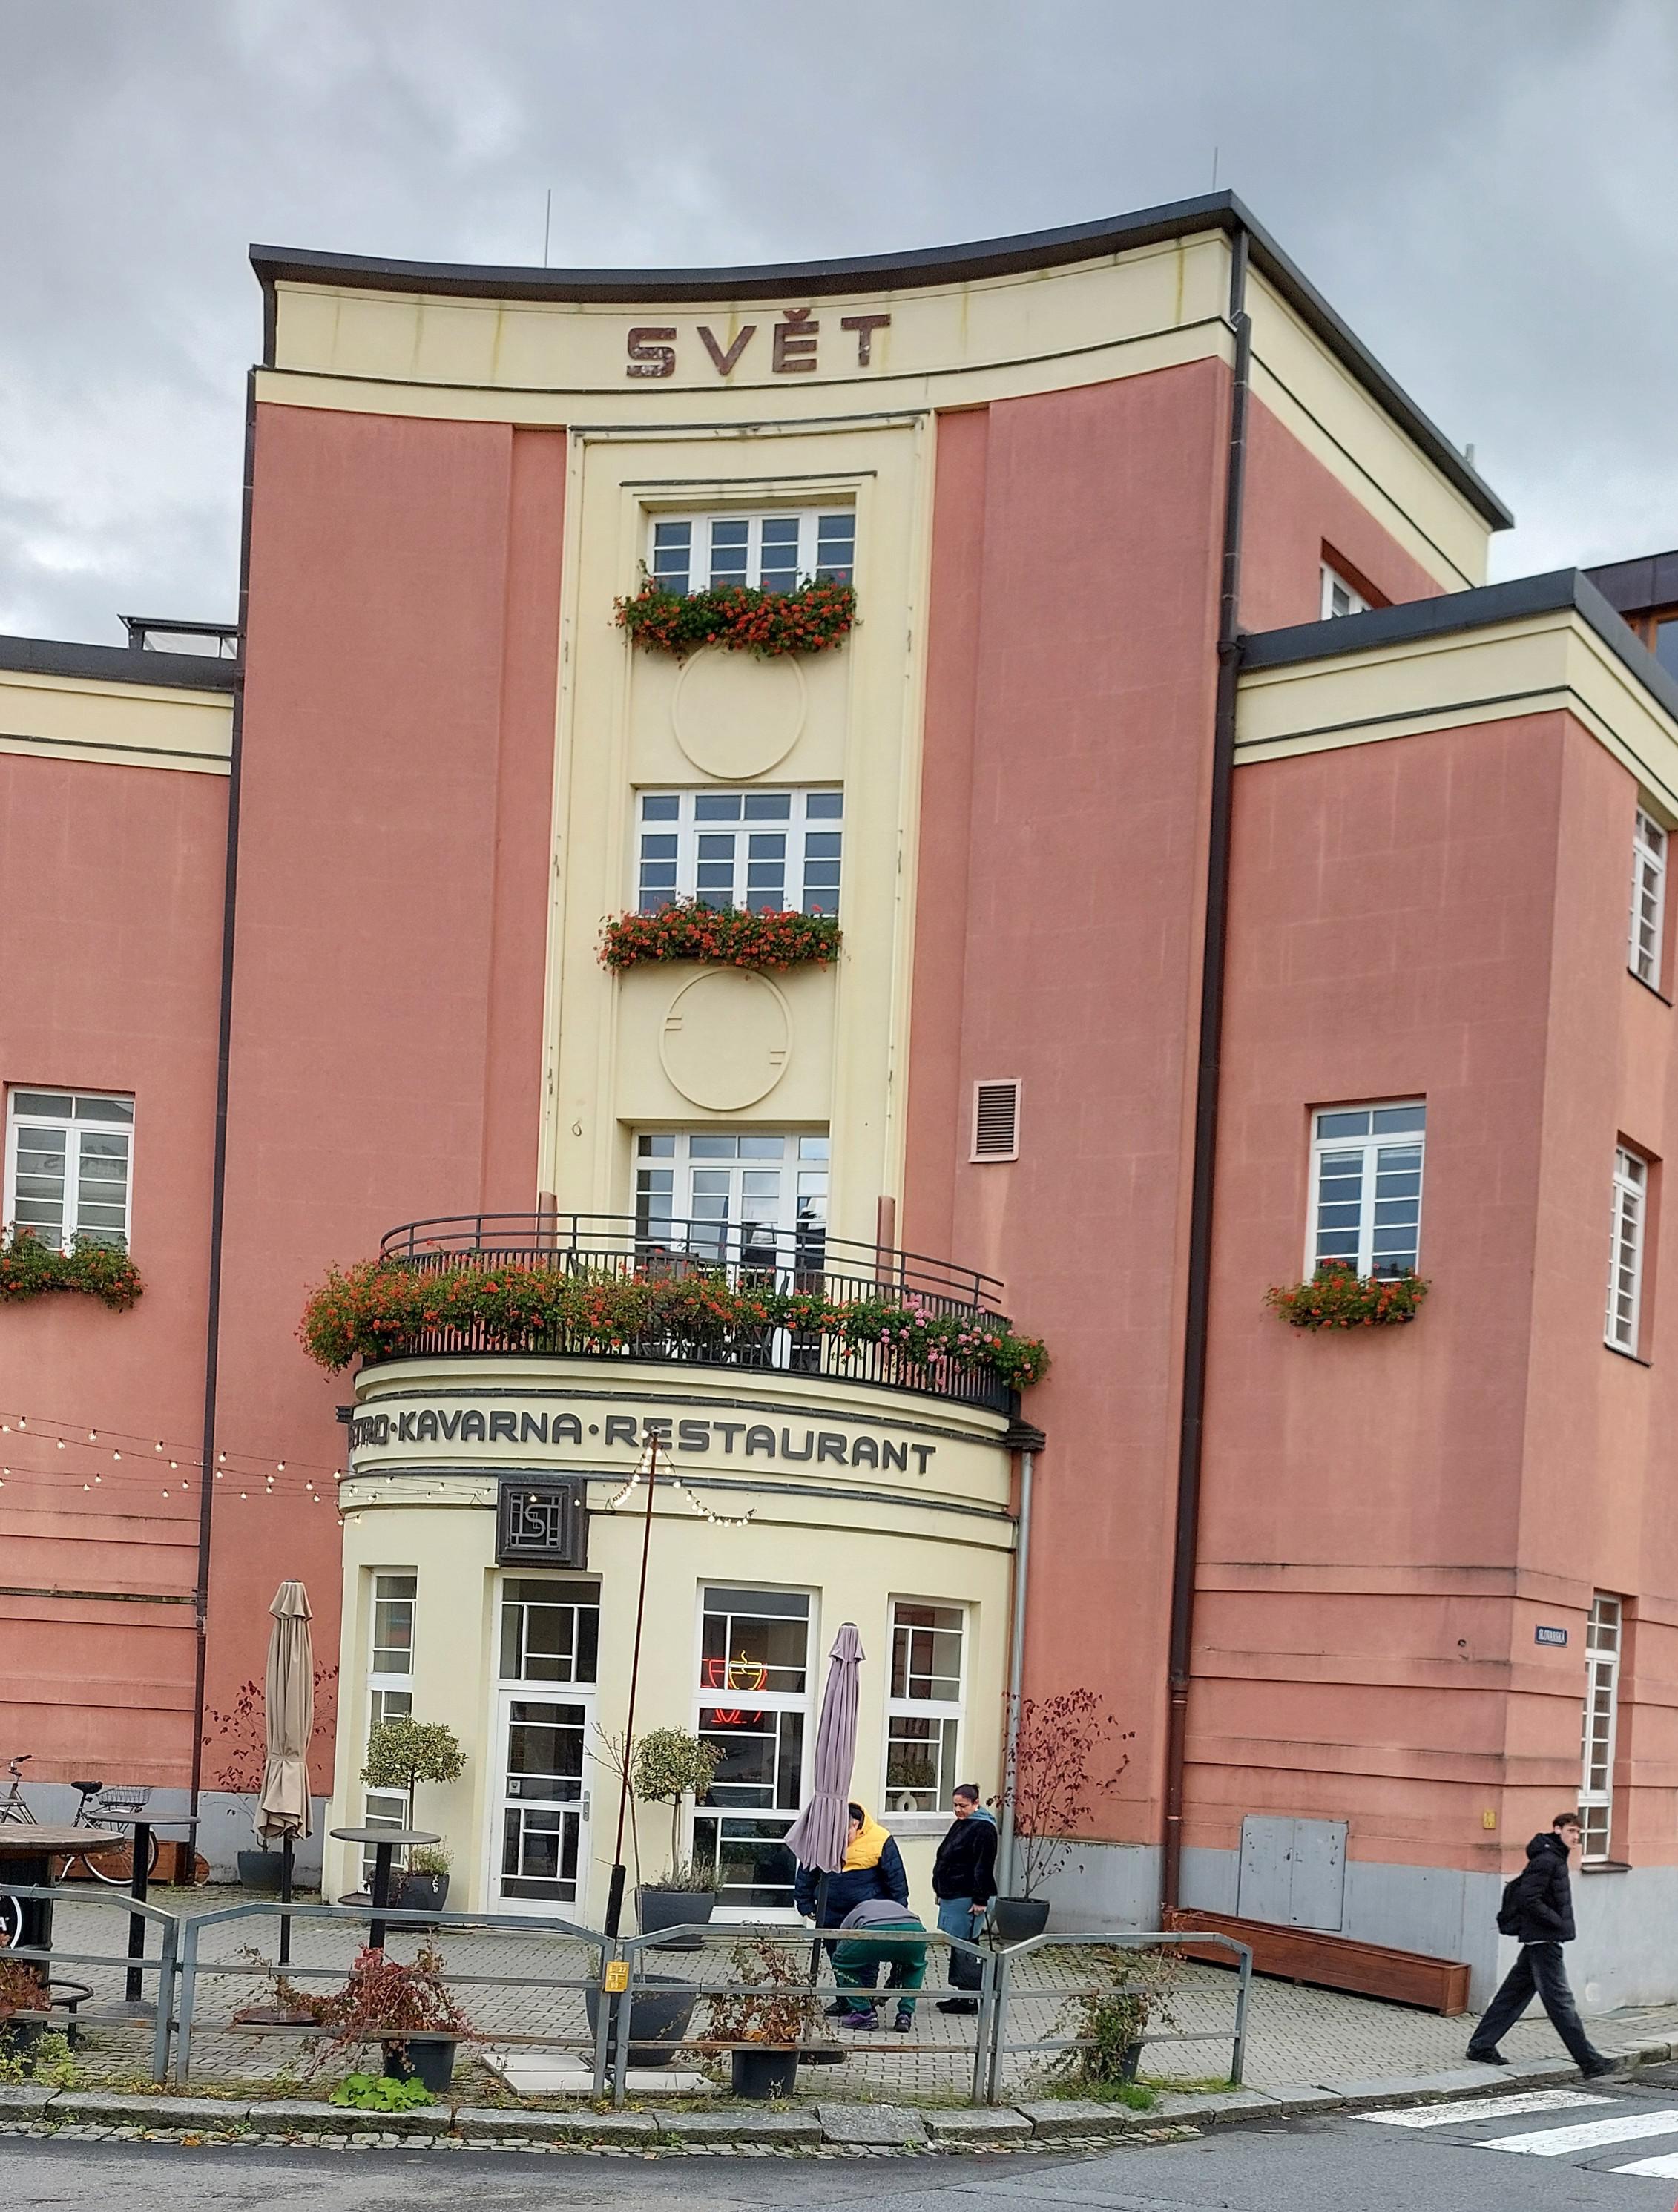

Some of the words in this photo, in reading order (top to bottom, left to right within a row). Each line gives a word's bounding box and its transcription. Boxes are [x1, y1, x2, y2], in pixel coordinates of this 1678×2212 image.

[627, 308, 892, 378] SVĚT
[398, 1409, 582, 1444] KAVARNA
[605, 1415, 936, 1475] RESTAURANT
